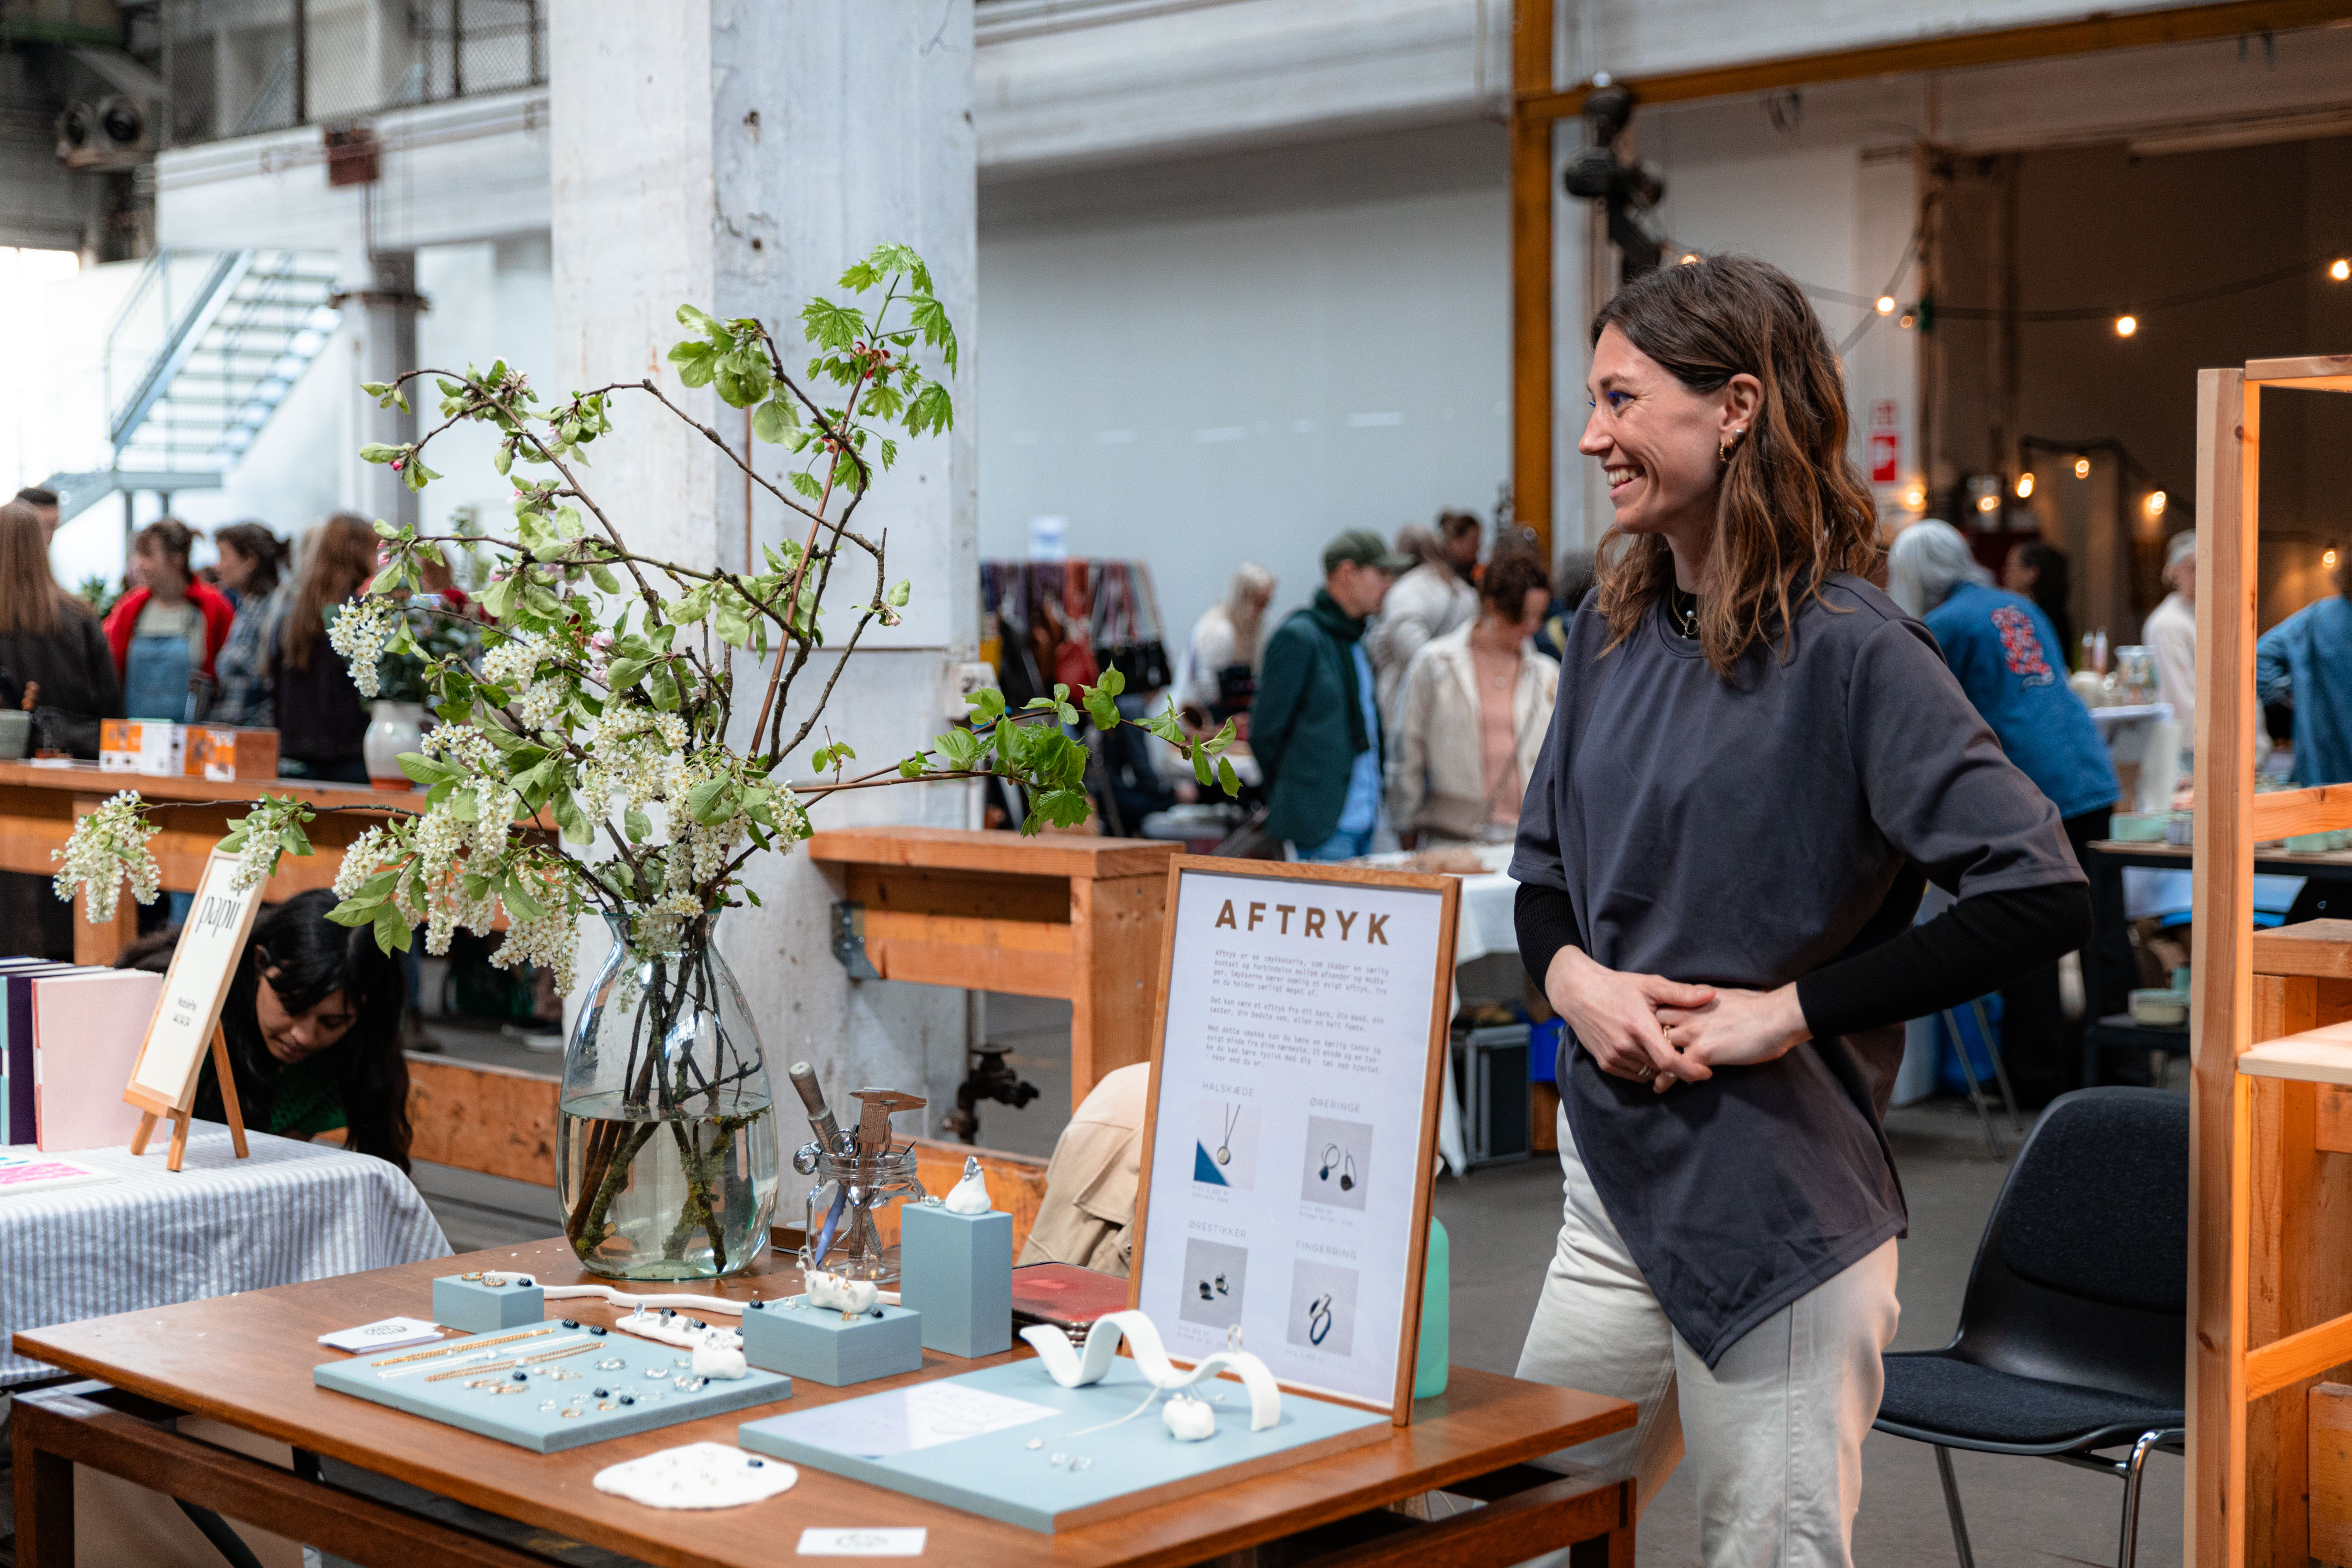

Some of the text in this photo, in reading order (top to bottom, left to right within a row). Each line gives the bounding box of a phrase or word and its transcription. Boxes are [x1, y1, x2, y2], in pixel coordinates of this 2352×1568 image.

[1214, 899, 1390, 945] AFTRYK
[1215, 950, 1236, 959] Aftryk
[1214, 959, 1238, 967] kontakt
[1253, 963, 1292, 974] forbindelse
[1321, 971, 1350, 980] afsender
[1231, 970, 1263, 980] Smykkerne
[1266, 974, 1284, 982] bærer
[1287, 978, 1309, 987] nemlig
[1323, 982, 1342, 990] evigt
[1233, 980, 1254, 988] holder
[1258, 984, 1282, 993] særligt
[1264, 1003, 1285, 1013] aftryk
[1251, 1011, 1272, 1020] bedste
[1293, 1017, 1312, 1025] eller
[1206, 1034, 1224, 1043] evigt
[1323, 1050, 1341, 1059] minde
[1221, 1026, 1240, 1034] dette
[1294, 1036, 1309, 1044] bære
[1350, 1044, 1369, 1053] tanke
[1241, 1048, 1256, 1056] bære
[1260, 1050, 1281, 1060] fysisk
[1299, 1056, 1311, 1066] dig
[1202, 1081, 1254, 1097] HALSKÆDE
[1309, 1096, 1361, 1114] ØRERINGE
[1188, 1218, 1247, 1240] ØRESTIKKER
[1295, 1239, 1357, 1261] FINGERRING
